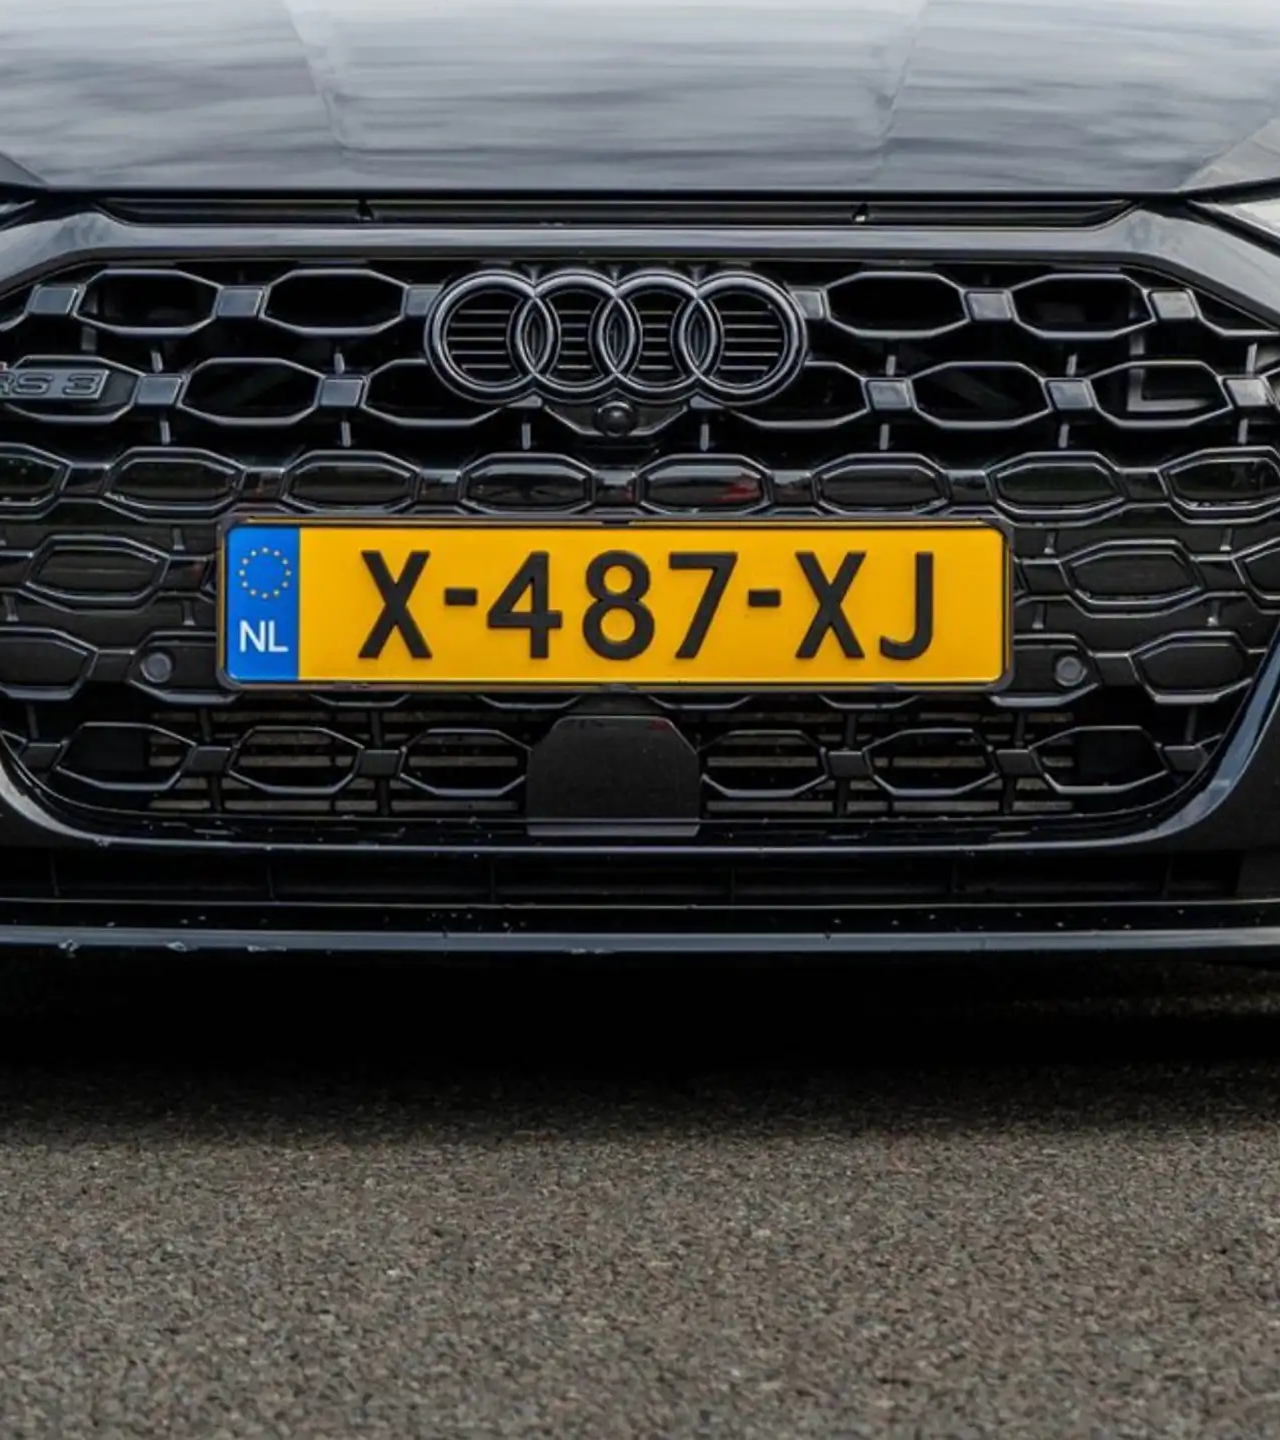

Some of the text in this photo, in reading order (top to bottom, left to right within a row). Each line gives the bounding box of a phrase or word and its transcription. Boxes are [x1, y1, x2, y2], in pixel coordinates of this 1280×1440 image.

[62, 371, 101, 397] 3
[357, 549, 935, 662] X-487-XJ
[239, 619, 289, 653] NL
